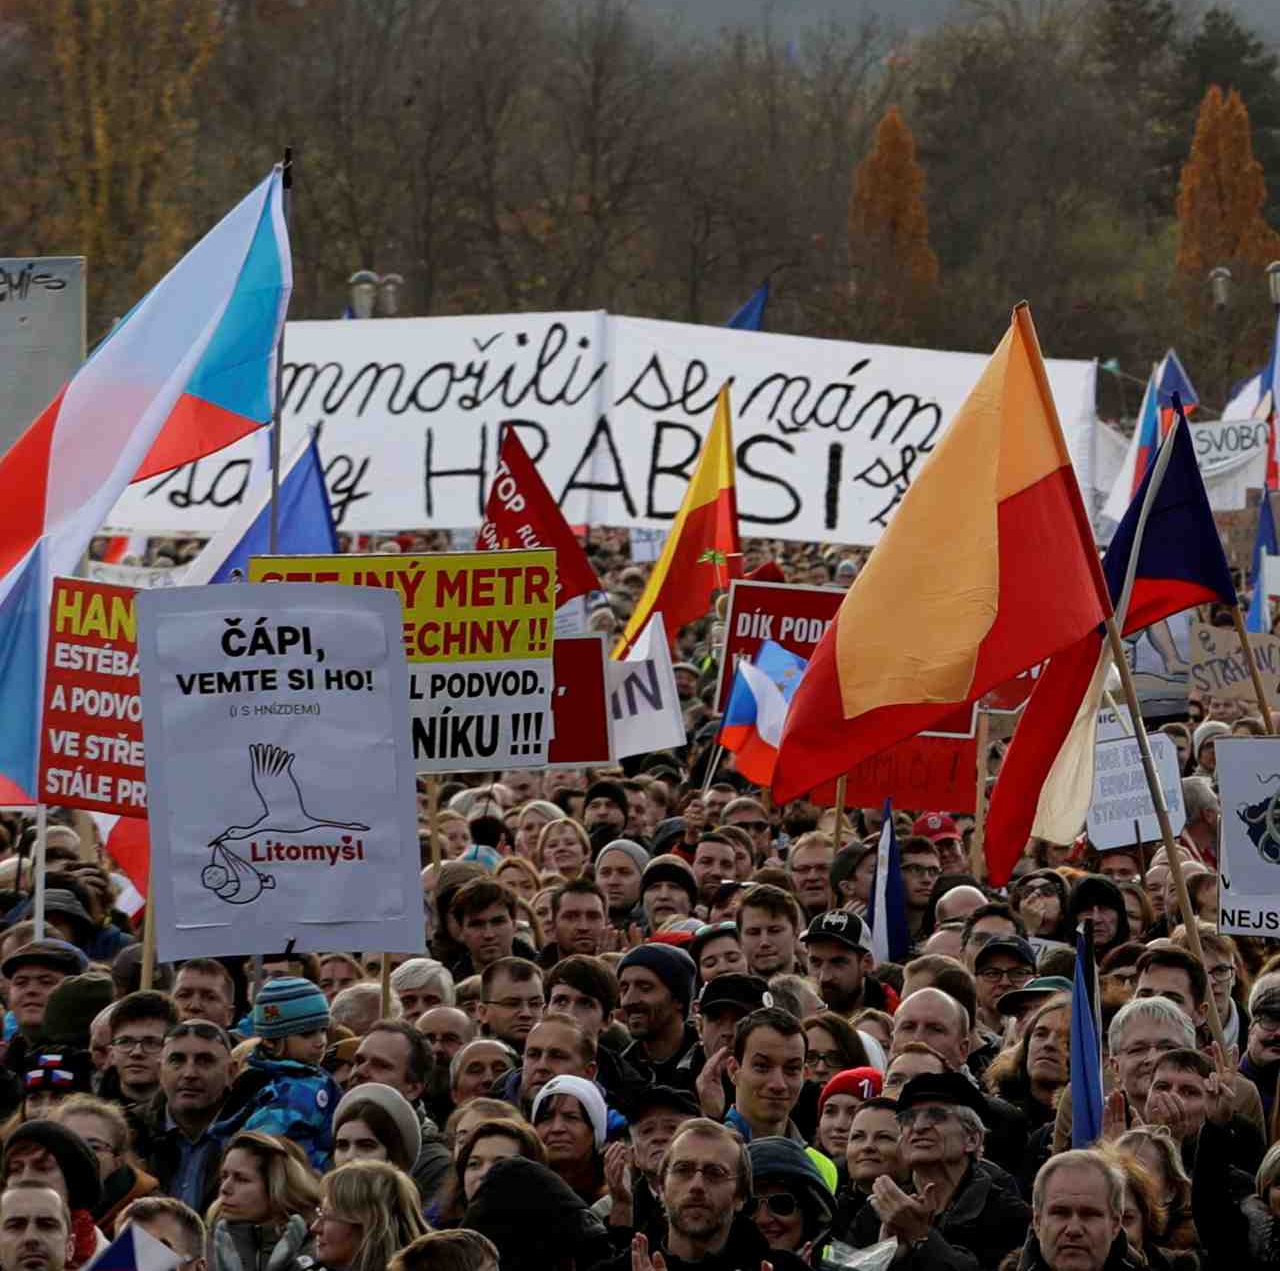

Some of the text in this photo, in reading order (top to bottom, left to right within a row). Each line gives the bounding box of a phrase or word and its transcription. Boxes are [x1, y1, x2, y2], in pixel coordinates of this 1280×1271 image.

[615, 354, 728, 414] se
[435, 566, 550, 607] METR
[736, 608, 774, 639] DÍK
[221, 616, 325, 662] ČÁPI,
[176, 668, 373, 696] VEMTE SI HO!
[431, 669, 545, 699] PODVOD.
[51, 684, 66, 711] A
[241, 705, 250, 716] S
[254, 702, 321, 716] HNÍZDEMI)
[49, 729, 80, 757] VE
[510, 712, 544, 756] !!!
[46, 765, 112, 802] STÁLE
[250, 836, 364, 865] Litomyšl
